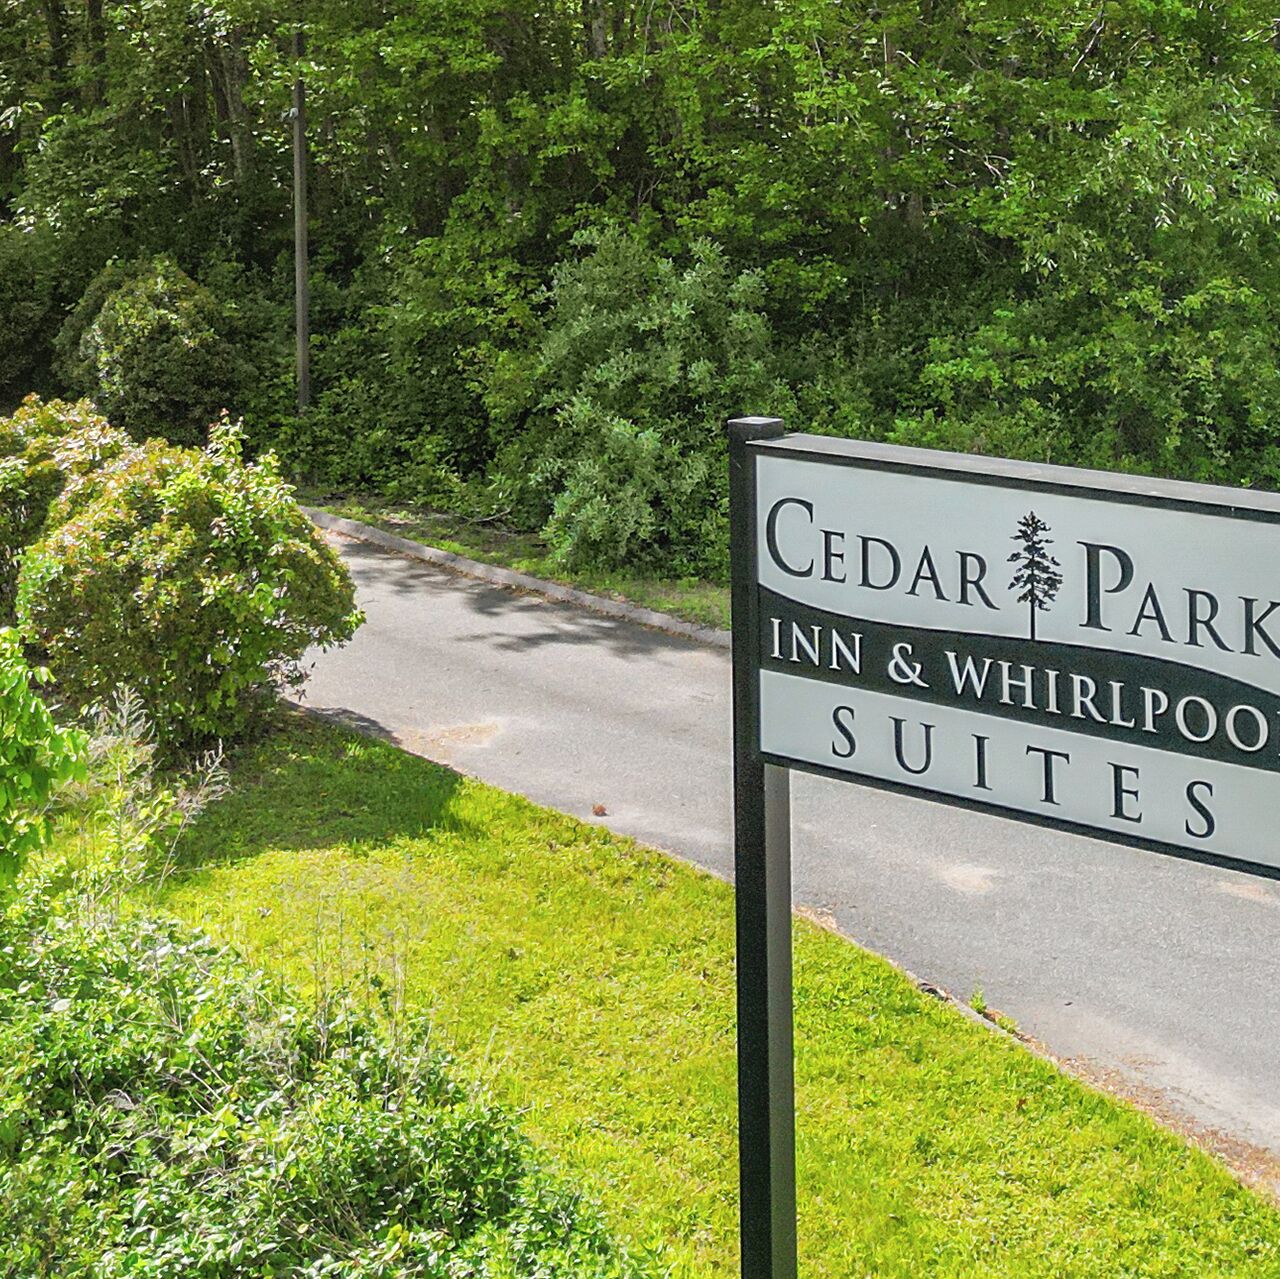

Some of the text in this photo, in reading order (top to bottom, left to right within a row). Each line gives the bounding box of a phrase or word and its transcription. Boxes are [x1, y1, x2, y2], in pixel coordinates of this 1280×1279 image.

[765, 497, 1000, 611] CEDAR
[769, 618, 863, 676] INN
[888, 642, 930, 688] &
[831, 705, 1216, 839] SUITES
